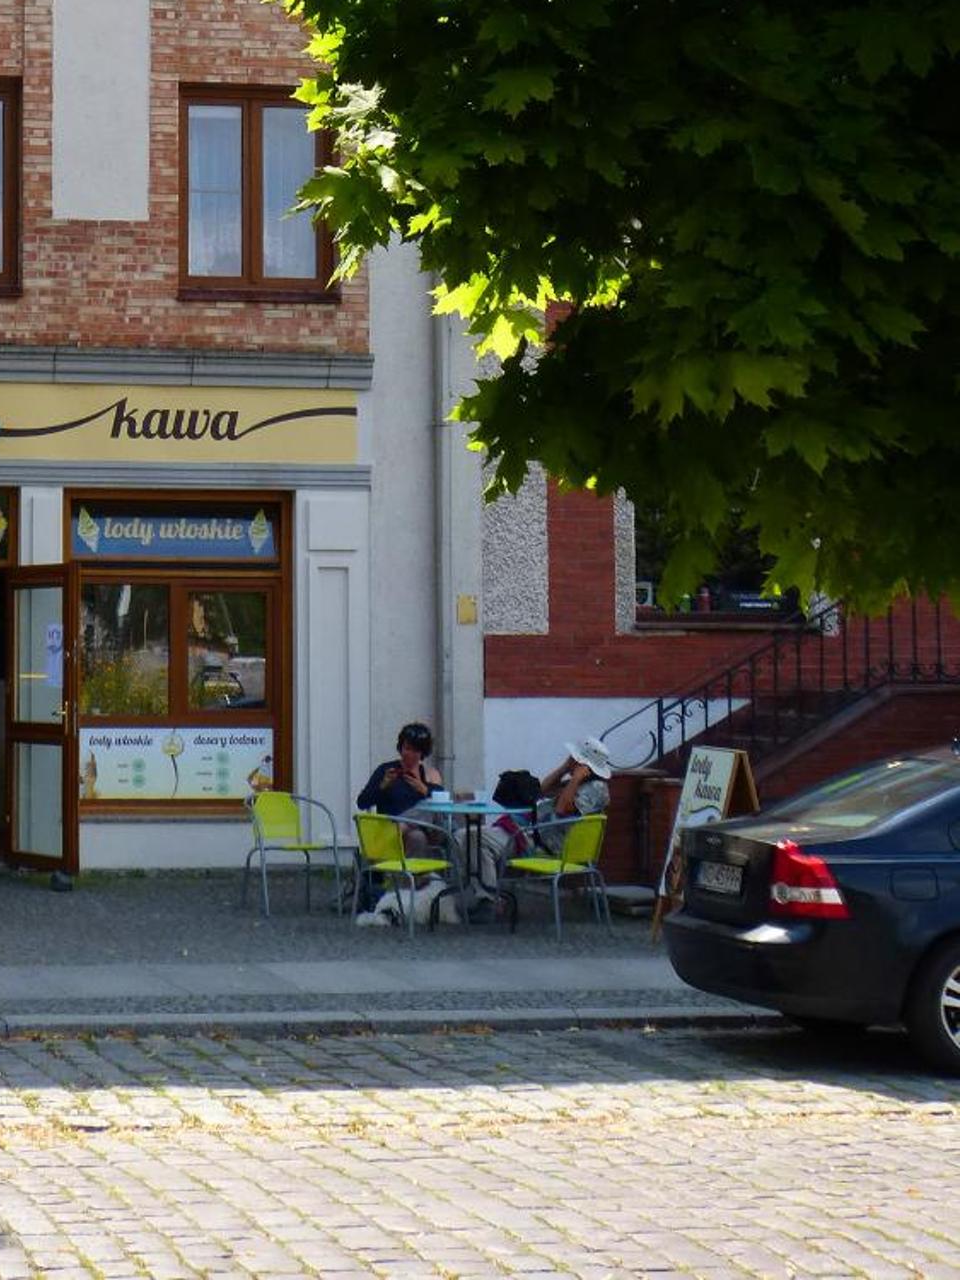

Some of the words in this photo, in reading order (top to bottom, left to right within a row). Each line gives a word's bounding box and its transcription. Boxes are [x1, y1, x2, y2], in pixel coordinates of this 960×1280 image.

[110, 396, 239, 441] kawa
[104, 518, 154, 546] lody
[159, 518, 244, 540] włoskie
[690, 754, 713, 781] lody
